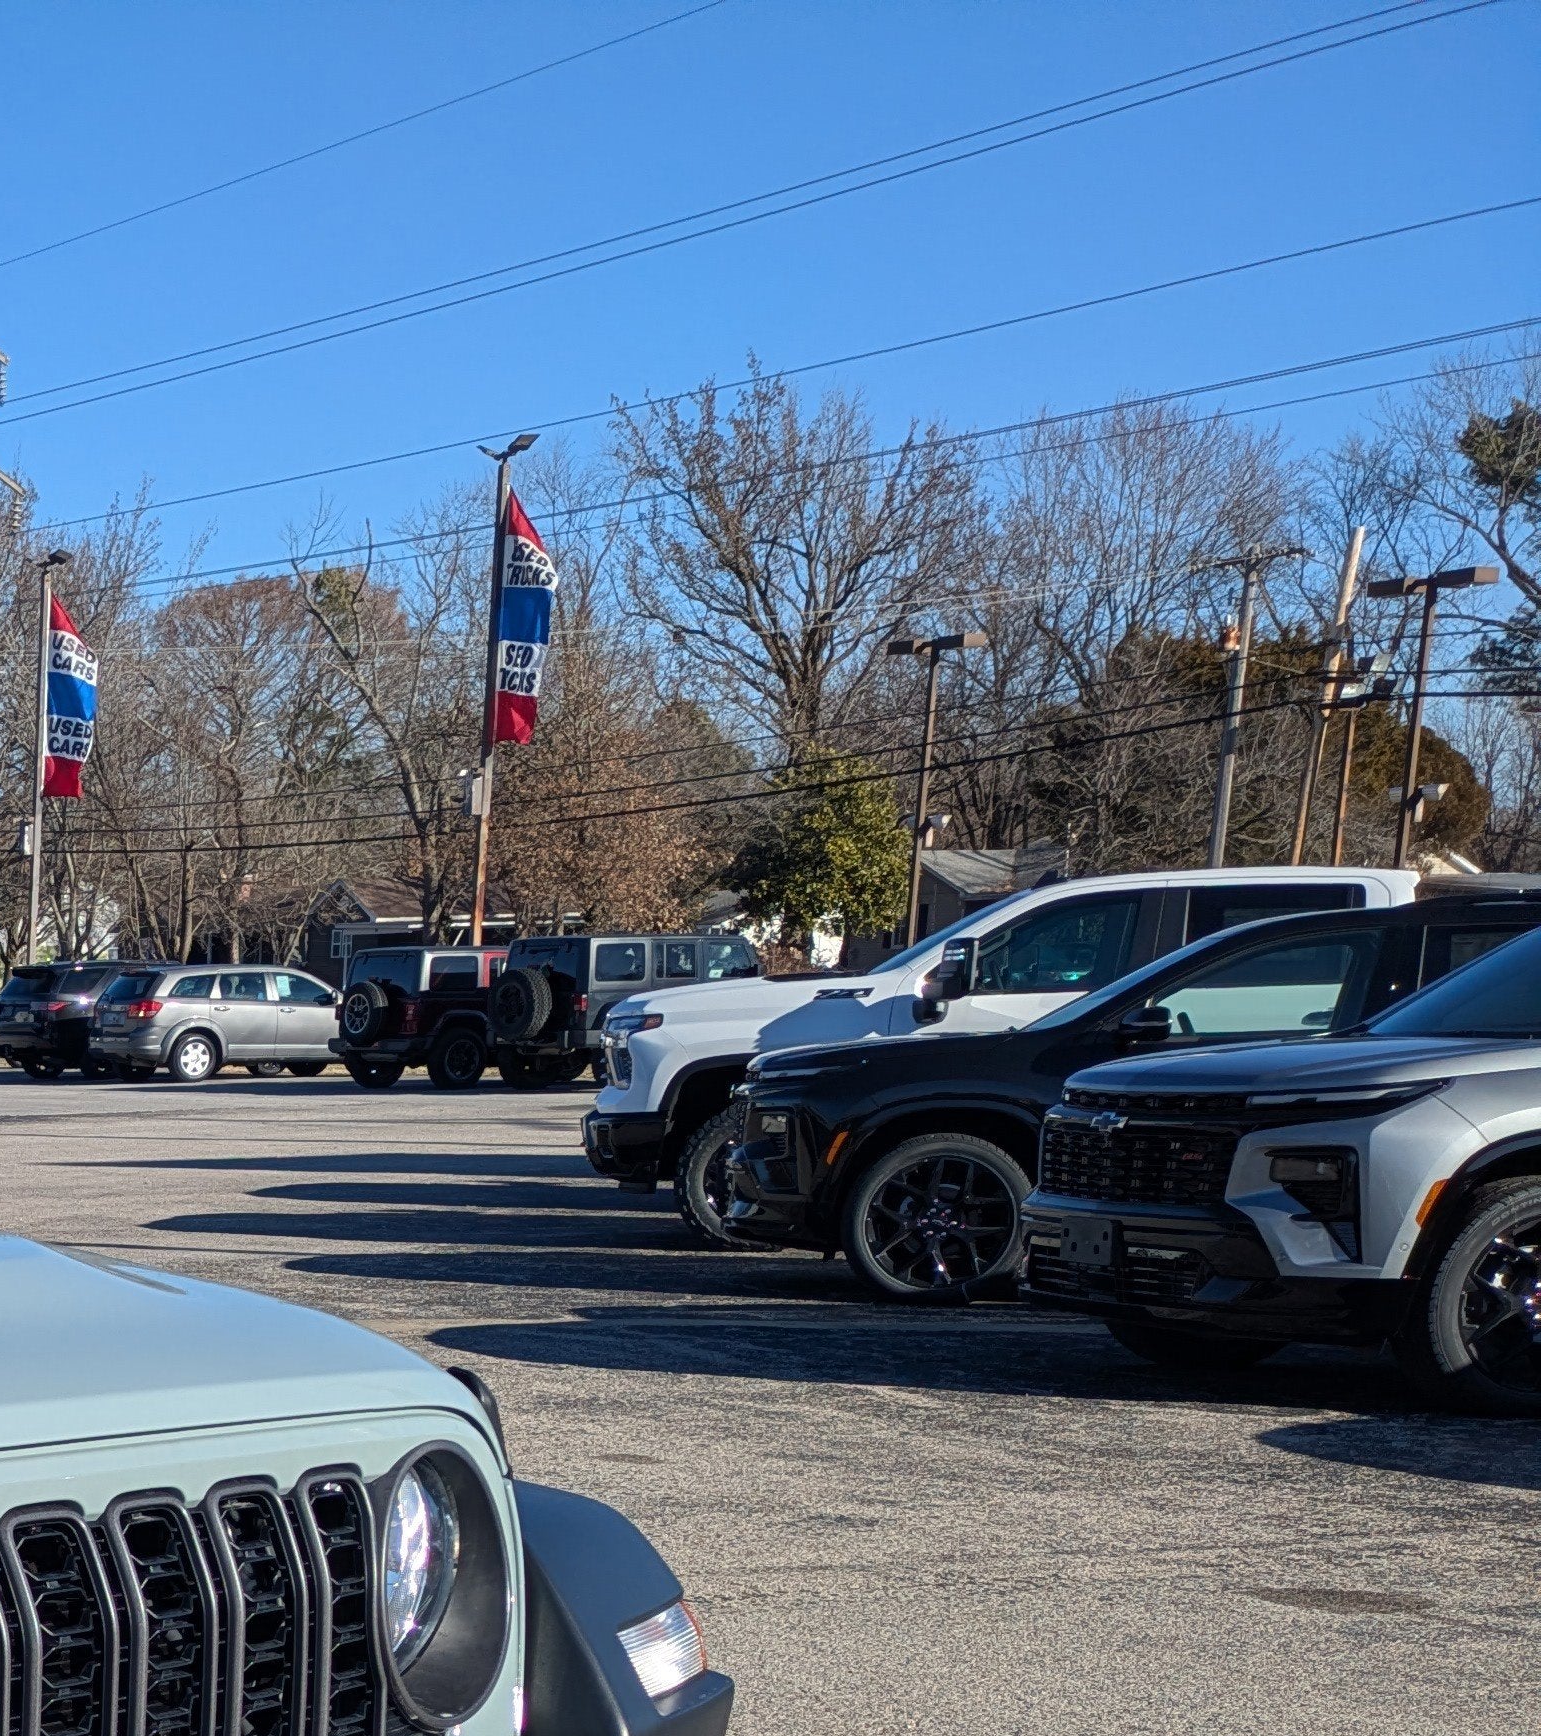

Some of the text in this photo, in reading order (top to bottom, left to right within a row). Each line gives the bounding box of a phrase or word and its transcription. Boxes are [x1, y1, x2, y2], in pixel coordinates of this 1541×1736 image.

[52, 632, 96, 663] USED
[52, 652, 95, 680] CARS
[48, 716, 93, 738] USED
